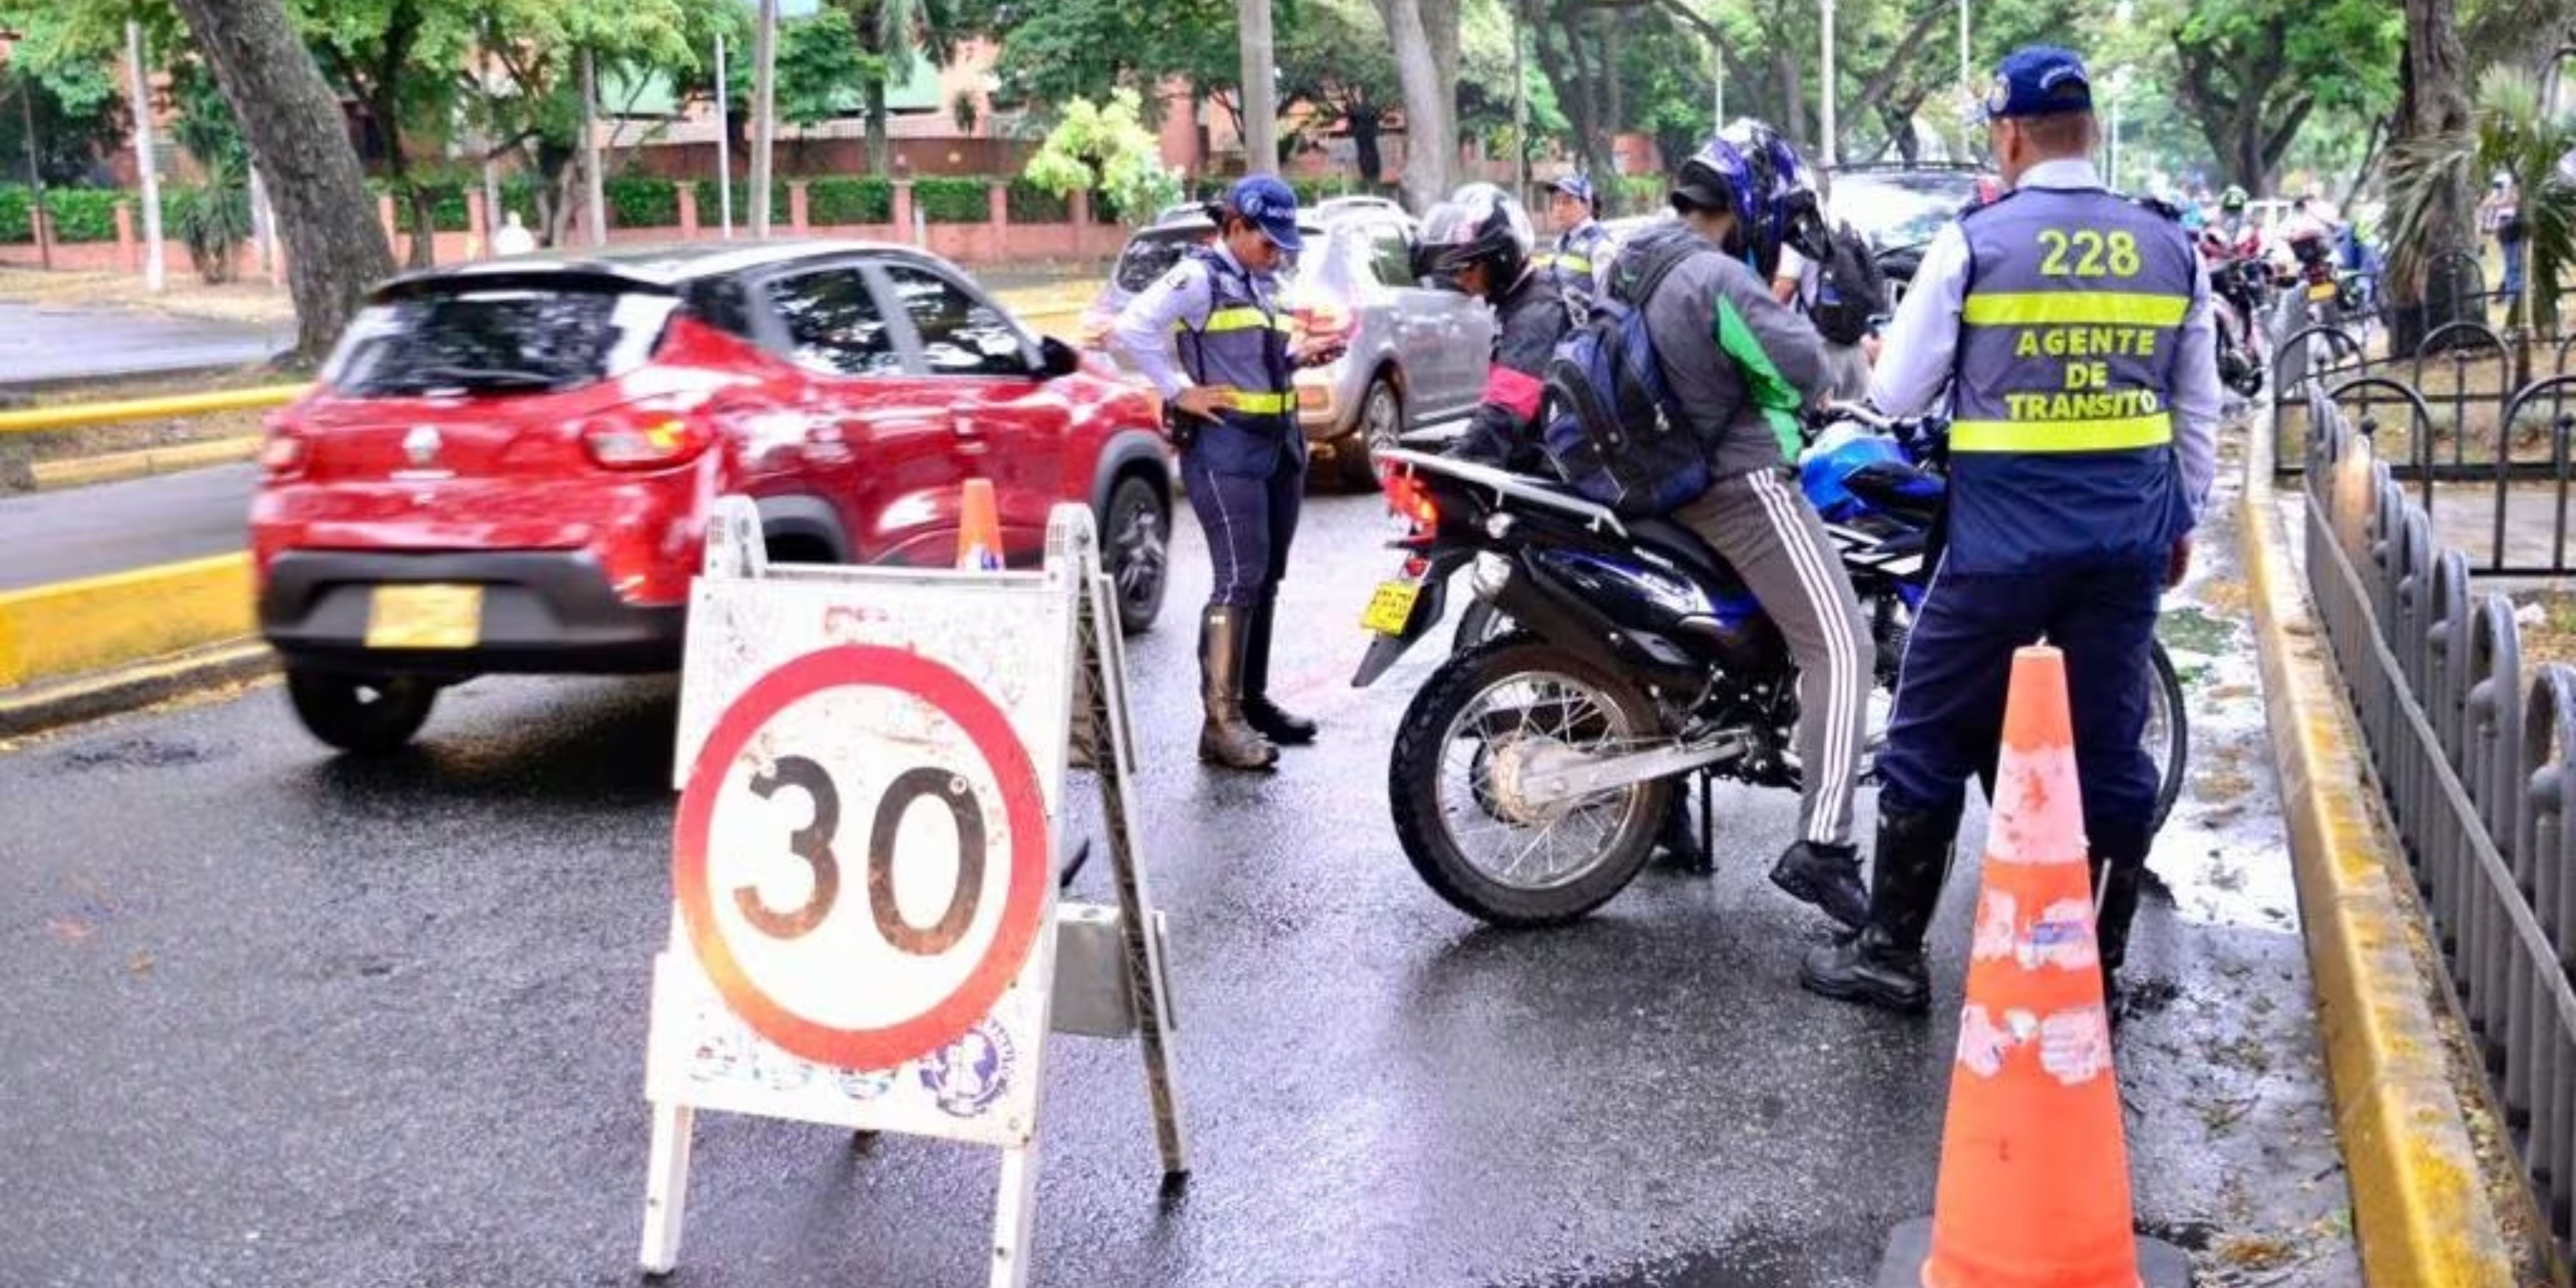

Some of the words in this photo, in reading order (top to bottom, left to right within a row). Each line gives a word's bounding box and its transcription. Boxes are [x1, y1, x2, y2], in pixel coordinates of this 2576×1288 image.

[2038, 230, 2139, 276] 228
[2016, 329, 2155, 354] AGENTE
[2066, 363, 2108, 388] DE
[2006, 390, 2156, 418] TRANSITO
[733, 755, 986, 956] 30
